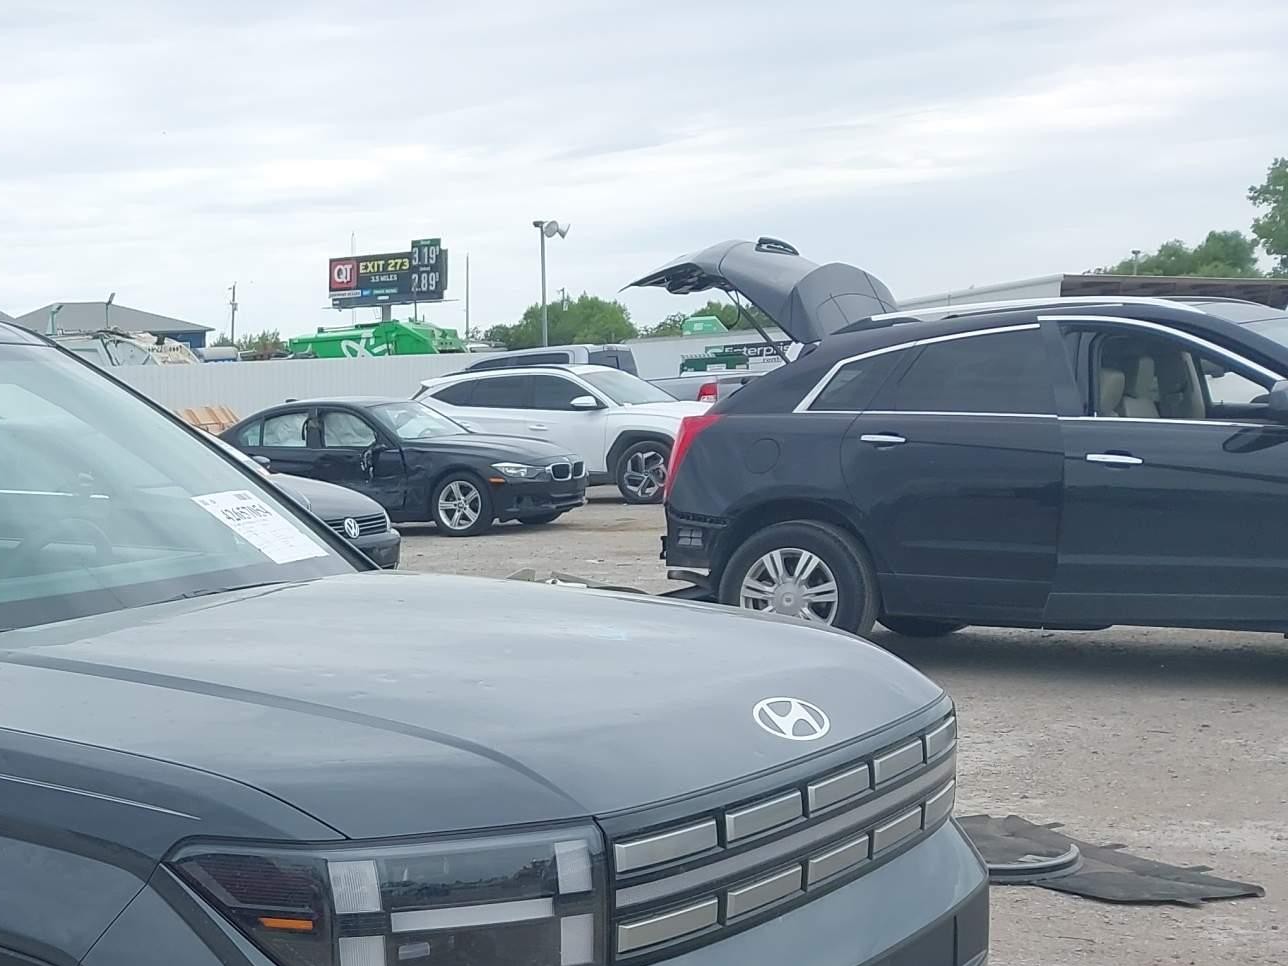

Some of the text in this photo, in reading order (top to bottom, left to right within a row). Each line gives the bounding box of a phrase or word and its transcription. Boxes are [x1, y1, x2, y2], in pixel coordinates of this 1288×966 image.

[334, 264, 353, 284] QT
[359, 258, 410, 274] EXIT 273
